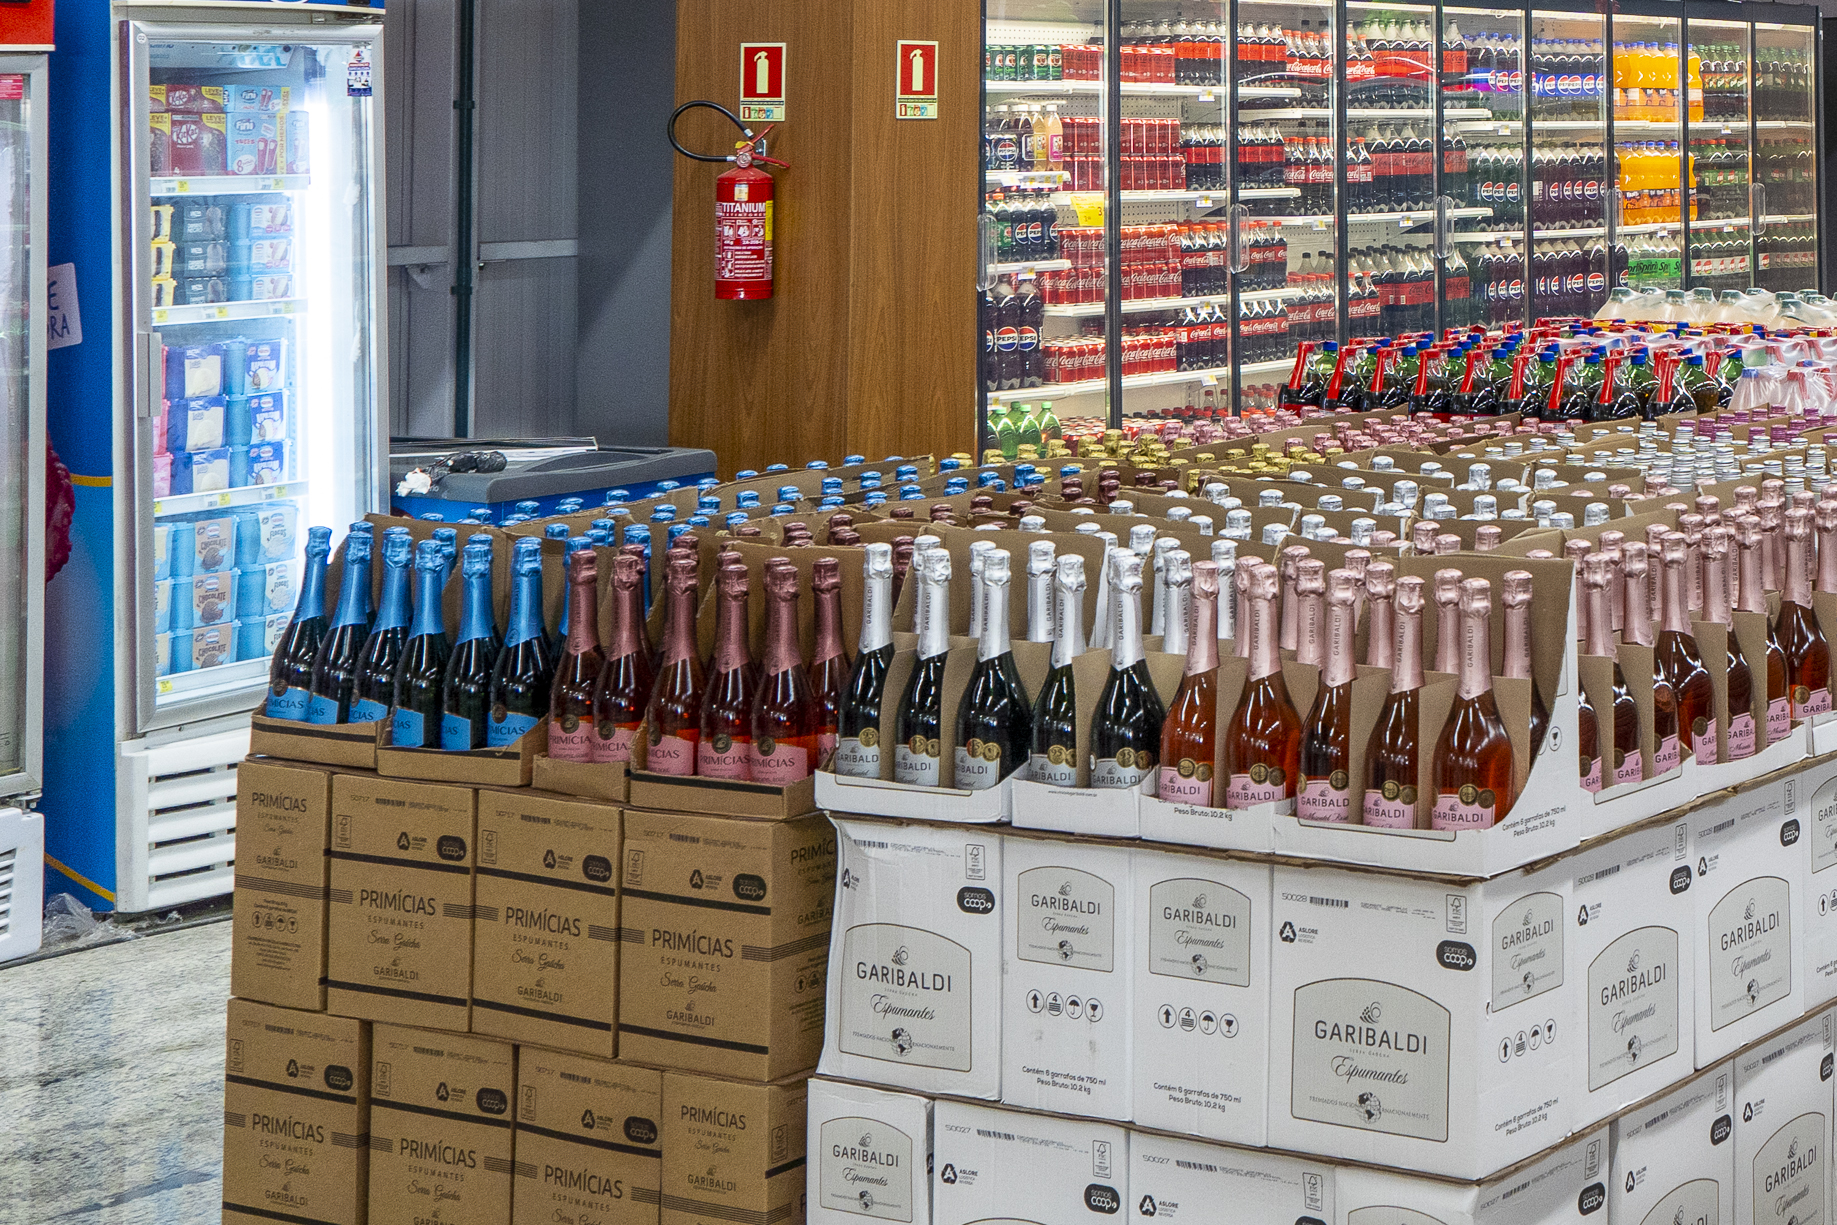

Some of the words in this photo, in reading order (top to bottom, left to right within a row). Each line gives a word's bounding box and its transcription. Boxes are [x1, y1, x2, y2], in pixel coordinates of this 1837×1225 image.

[722, 202, 766, 213] TITANIUM
[996, 336, 1018, 344] PEPSI
[199, 592, 226, 601] CHOCOLATE
[252, 792, 308, 813] PRIMÍCIAS
[1301, 796, 1350, 808] GARIBALD
[1174, 807, 1189, 817] Peso
[1224, 812, 1232, 822] kg
[256, 854, 298, 870] GARIBALDI
[360, 888, 436, 916] PRIMÍCIAS
[1031, 894, 1101, 916] GARIBALDI
[1281, 892, 1308, 903] 50028
[506, 906, 581, 936] PRIMÍCIAS
[1163, 906, 1236, 929] GARIBALDI
[1501, 918, 1554, 950] GARIBALDI
[1720, 910, 1780, 952] GARIBALDI
[652, 928, 734, 958] PRIMÍCIAS
[373, 966, 419, 981] GARIBALDI
[856, 961, 951, 992] GARIBALDI
[1600, 962, 1667, 1007] GARIBALDI
[517, 986, 562, 1002] GARIBALDI
[666, 1010, 714, 1026] GARIBALDI
[1314, 1020, 1428, 1055] GARIBALDI
[252, 1112, 324, 1144] PRIMÍCIAS
[680, 1104, 747, 1131] PRIMÍCIAS
[945, 1124, 972, 1134] 50027
[400, 1138, 477, 1169] PRIMÍCIAS
[832, 1144, 899, 1168] GARIBALDI
[1142, 1154, 1170, 1165] 50027
[1765, 1145, 1818, 1194] GARIBALDI
[544, 1164, 624, 1200] PRIMÍCIAS
[687, 1174, 736, 1192] GARIBALDI
[264, 1190, 308, 1206] GARIBALDI
